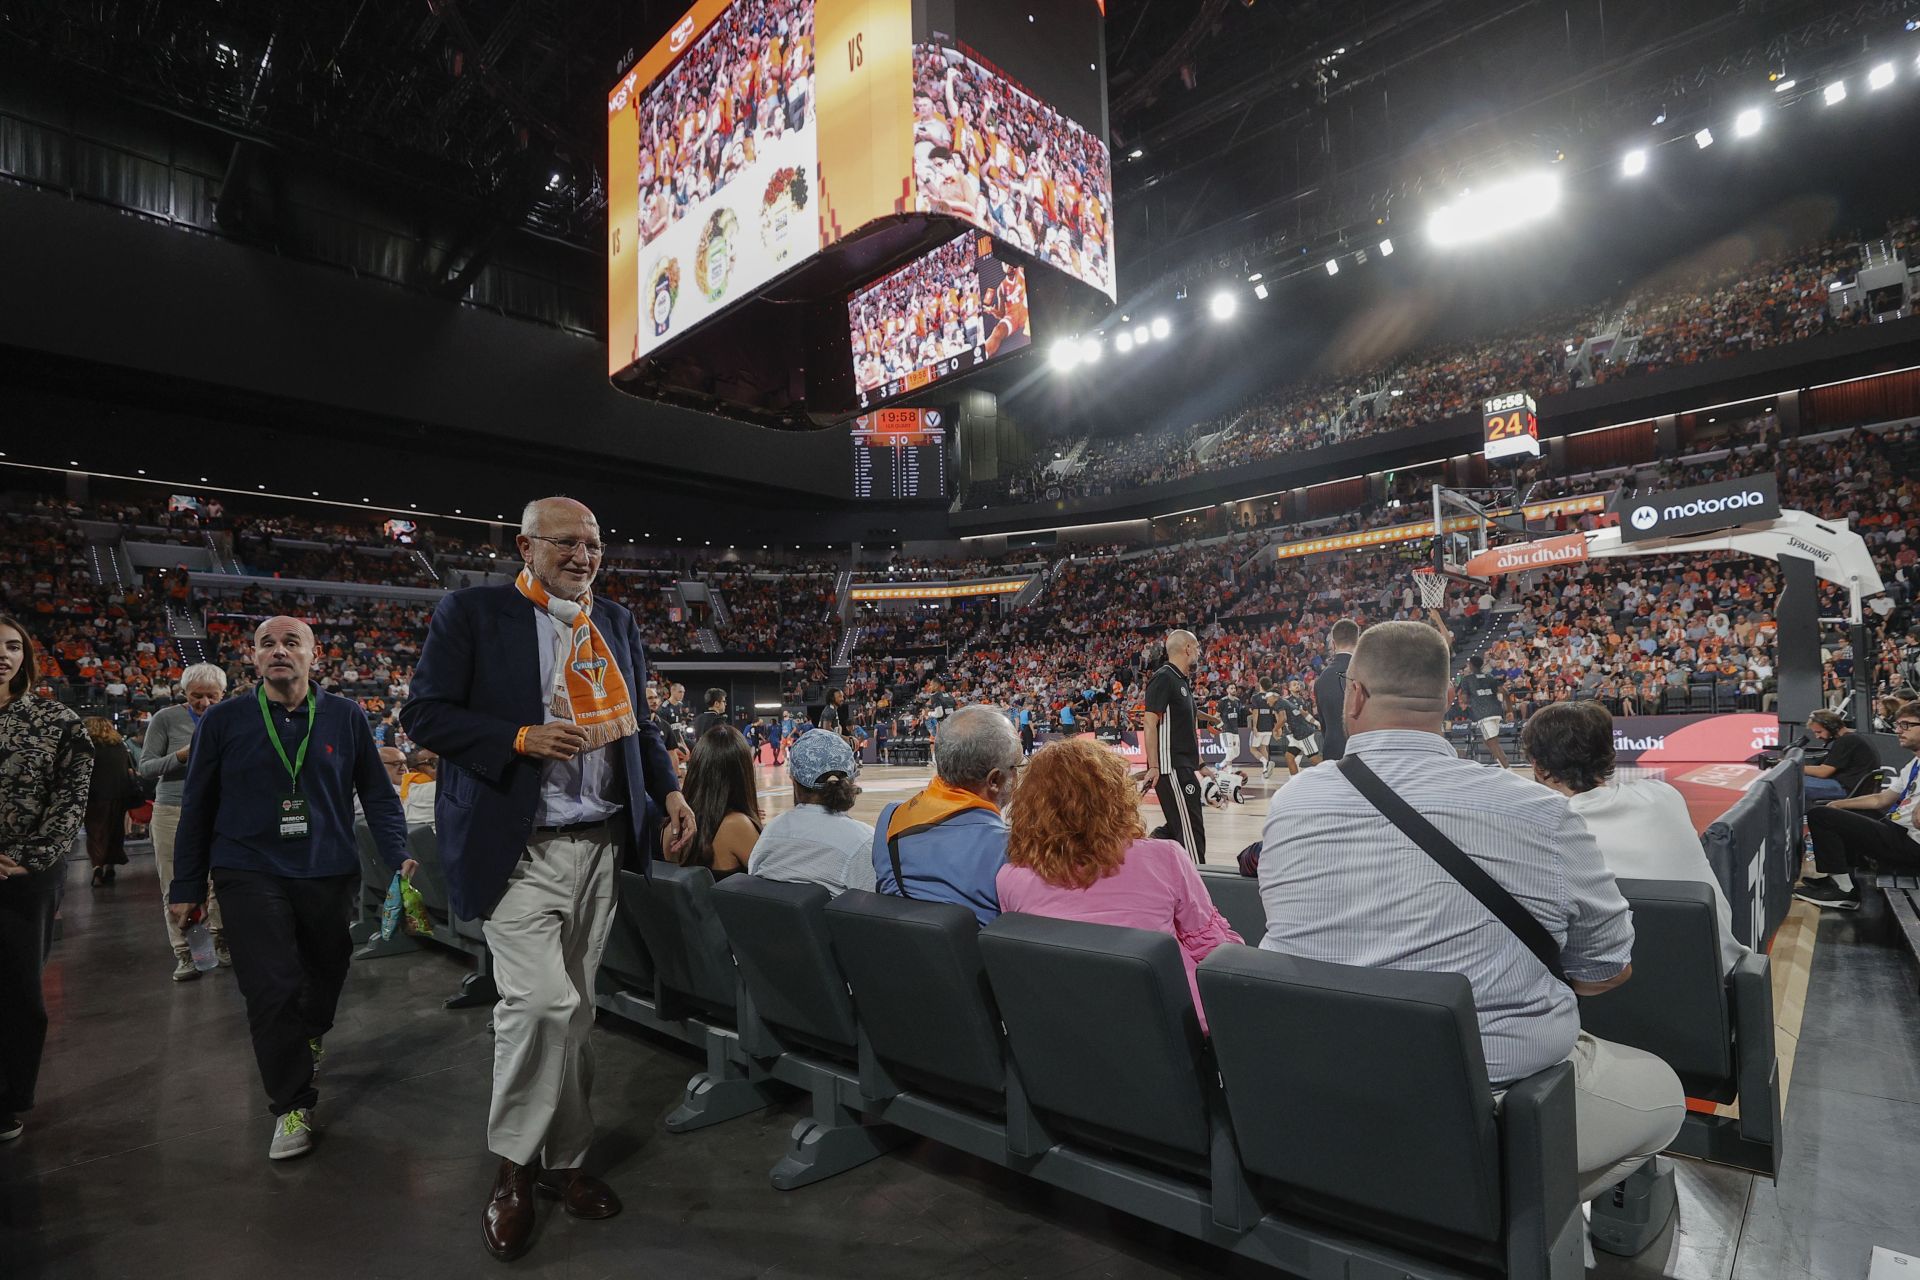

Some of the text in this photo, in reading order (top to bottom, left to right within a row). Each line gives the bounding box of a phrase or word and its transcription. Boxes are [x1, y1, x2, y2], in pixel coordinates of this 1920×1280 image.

[623, 48, 634, 68] LG
[848, 32, 863, 72] VS
[951, 358, 959, 370] 0
[880, 386, 887, 398] 3
[1485, 393, 1524, 412] 19:58
[881, 412, 916, 422] 19:58
[1488, 412, 1523, 441] 24
[1528, 413, 1538, 440] 24
[889, 436, 896, 445] 3
[900, 436, 908, 445] 0
[1663, 491, 1764, 521] motorola
[1497, 543, 1582, 568] abu dhabi
[1787, 537, 1832, 562] SPALDING
[1613, 735, 1665, 750] dhabi
[1751, 734, 1778, 749] ab
